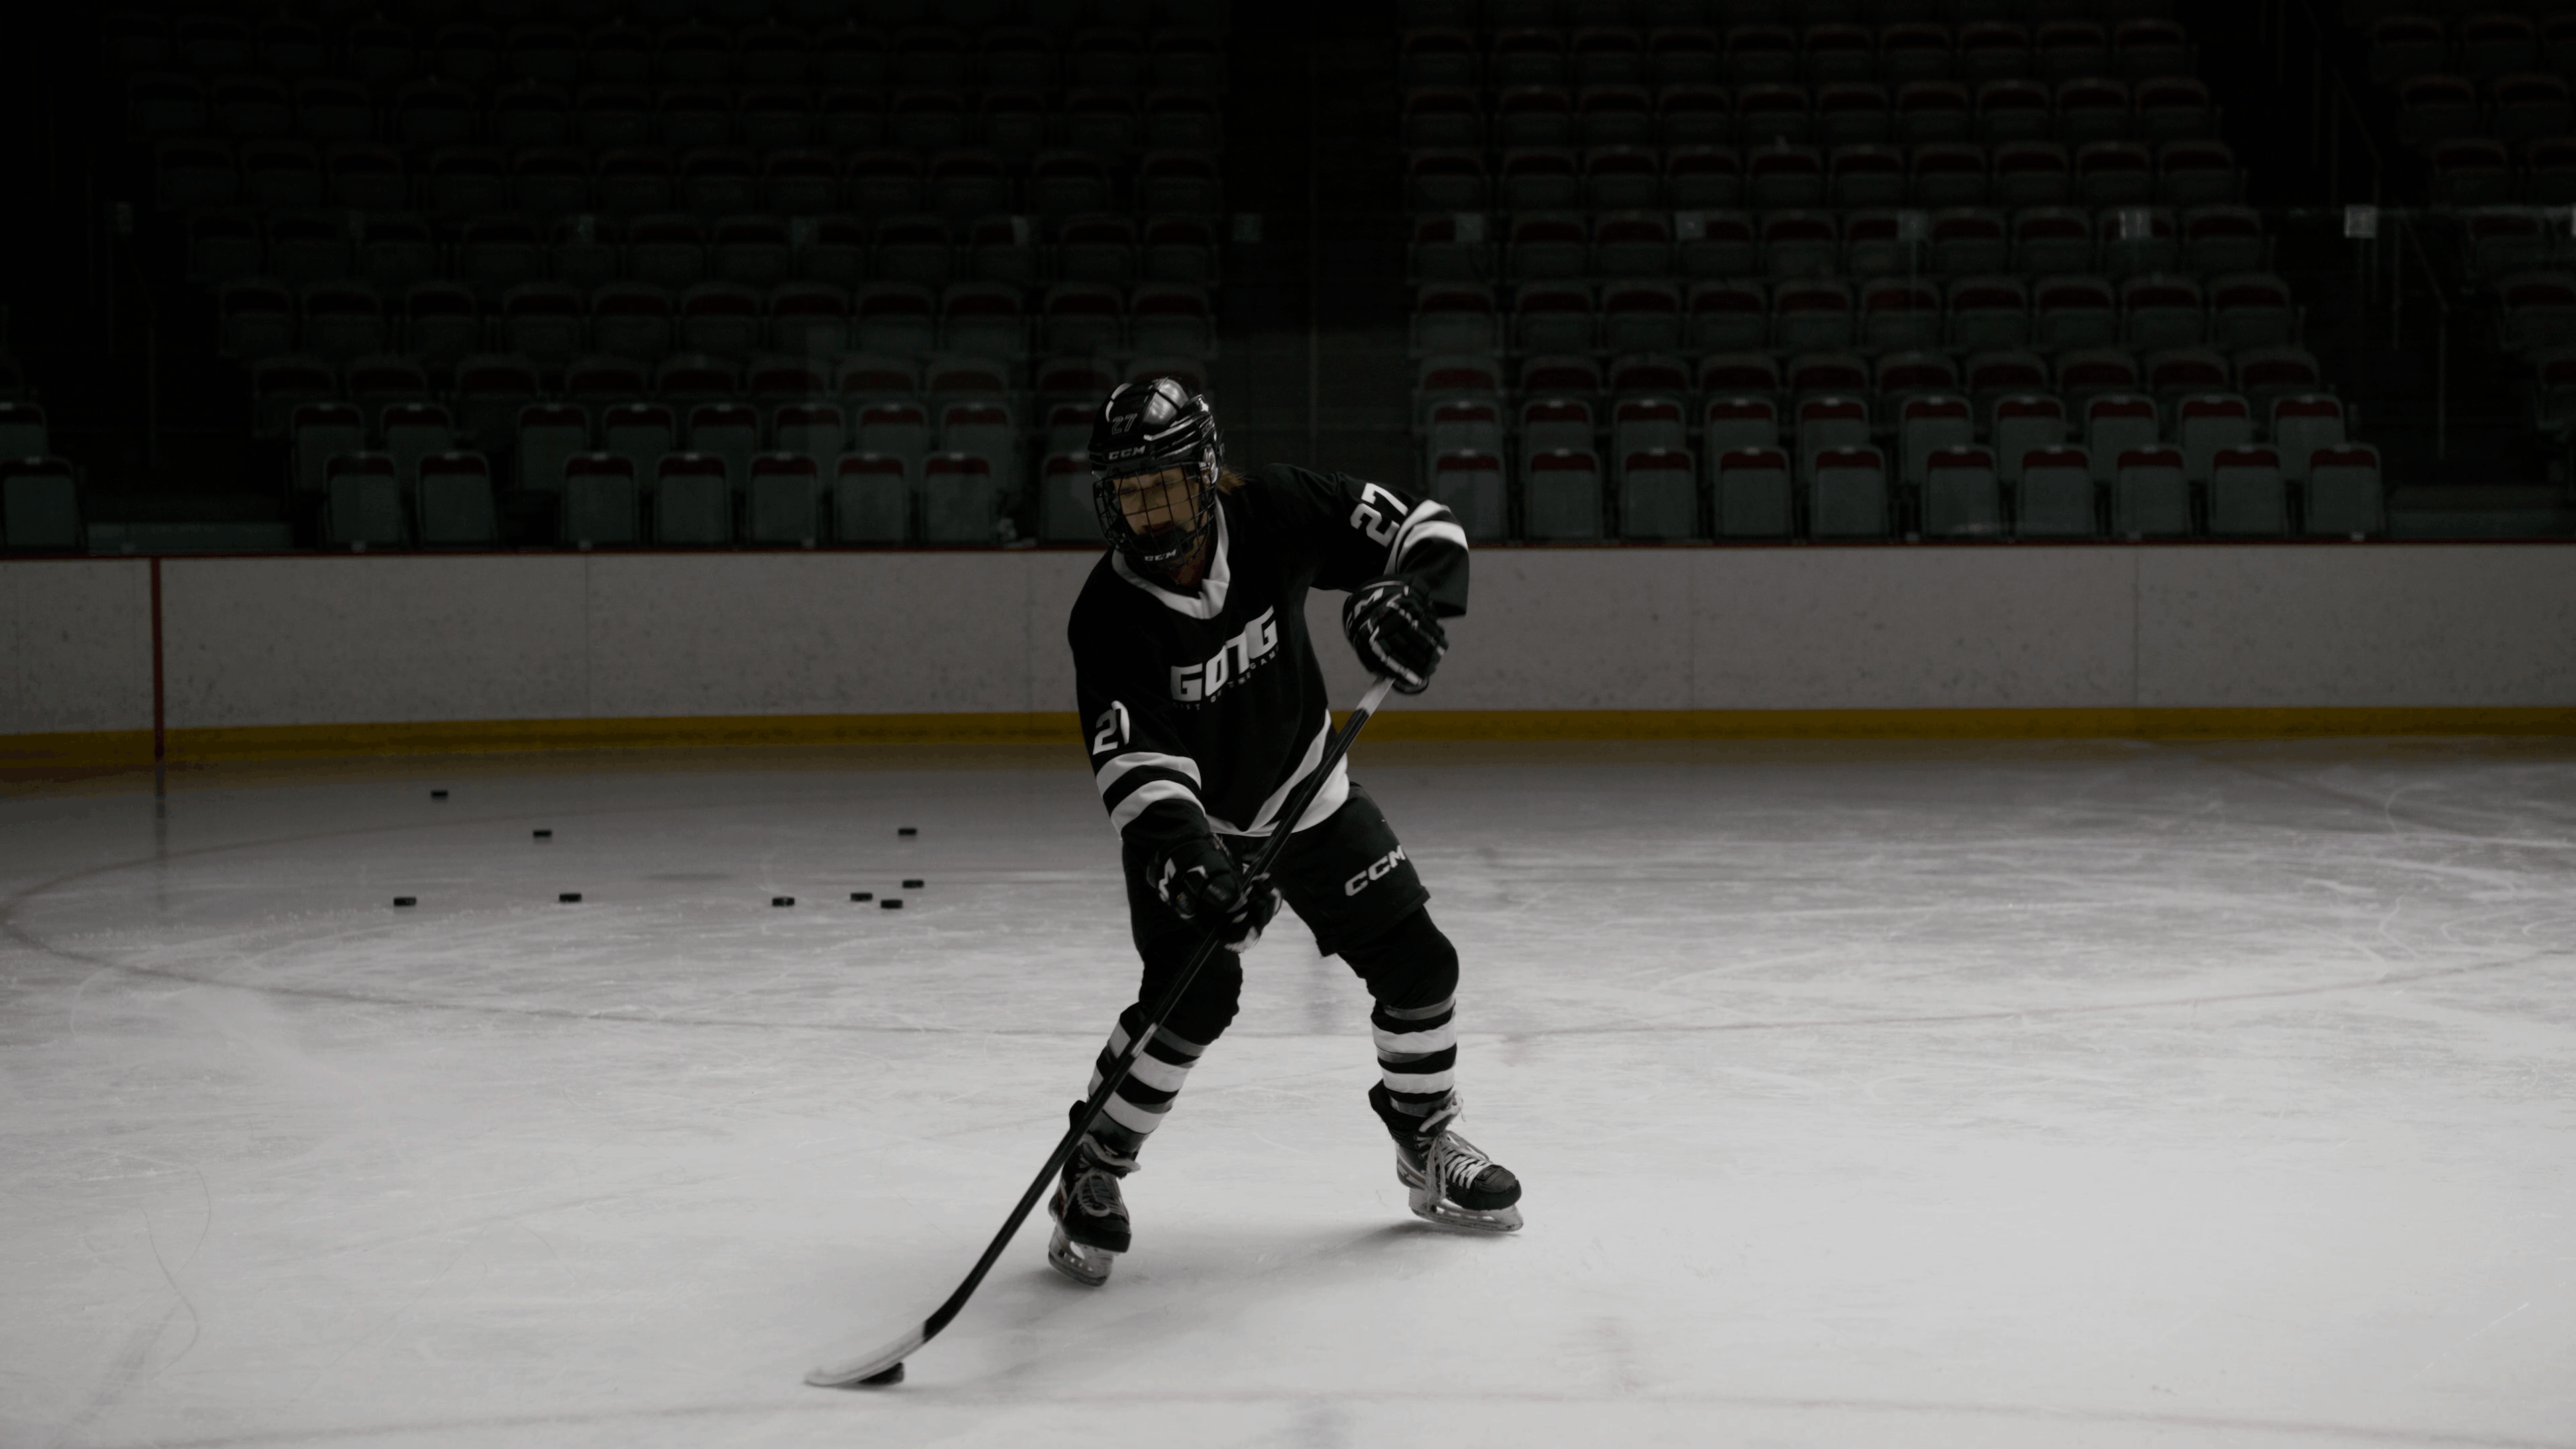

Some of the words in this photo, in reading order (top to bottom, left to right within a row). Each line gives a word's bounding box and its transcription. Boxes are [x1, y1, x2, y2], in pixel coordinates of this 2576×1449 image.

[1112, 413, 1137, 435] 27
[1108, 445, 1146, 460] CCM
[1350, 482, 1409, 547] 27
[1144, 549, 1176, 562] CCM
[1344, 845, 1406, 896] CCM
